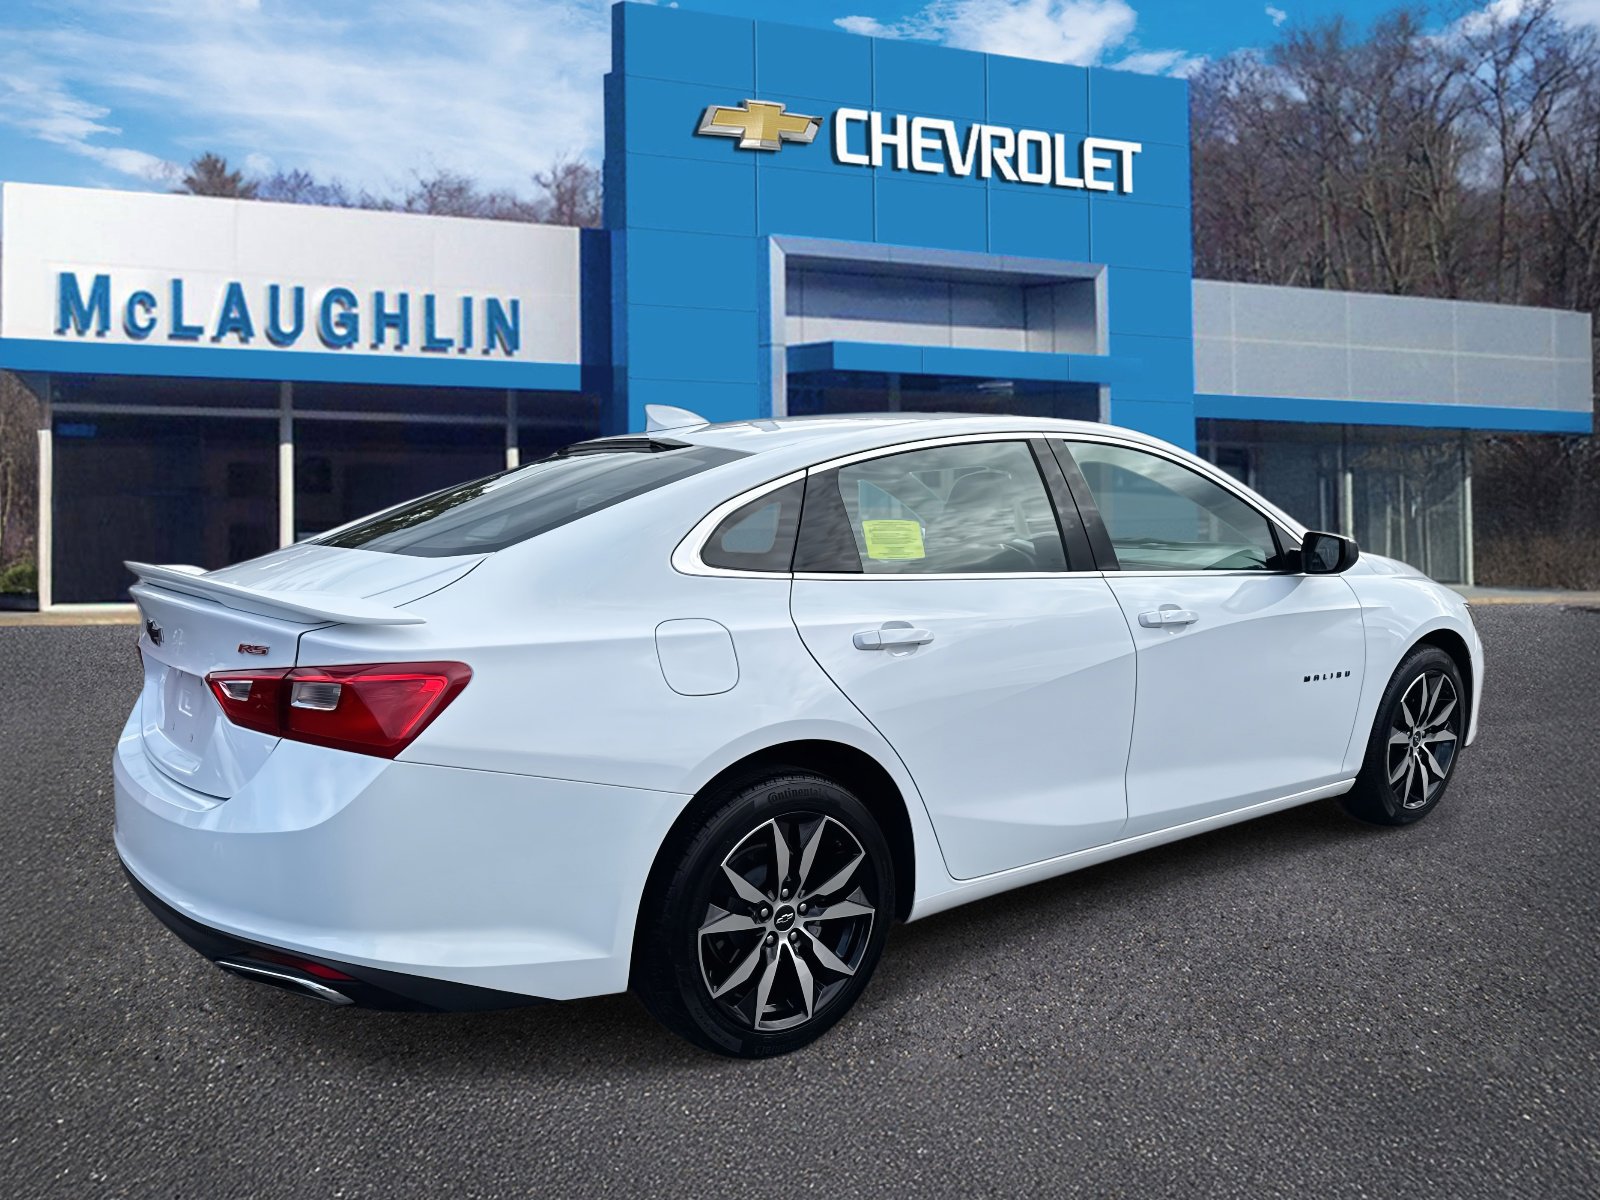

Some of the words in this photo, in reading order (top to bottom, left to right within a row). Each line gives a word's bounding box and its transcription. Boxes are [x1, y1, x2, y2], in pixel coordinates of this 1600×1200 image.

[833, 107, 1142, 193] CHEVROLET
[55, 271, 520, 357] McLAUGHLIN
[238, 643, 270, 656] RS
[1303, 670, 1351, 683] MALIBU
[767, 787, 822, 804] Continental
